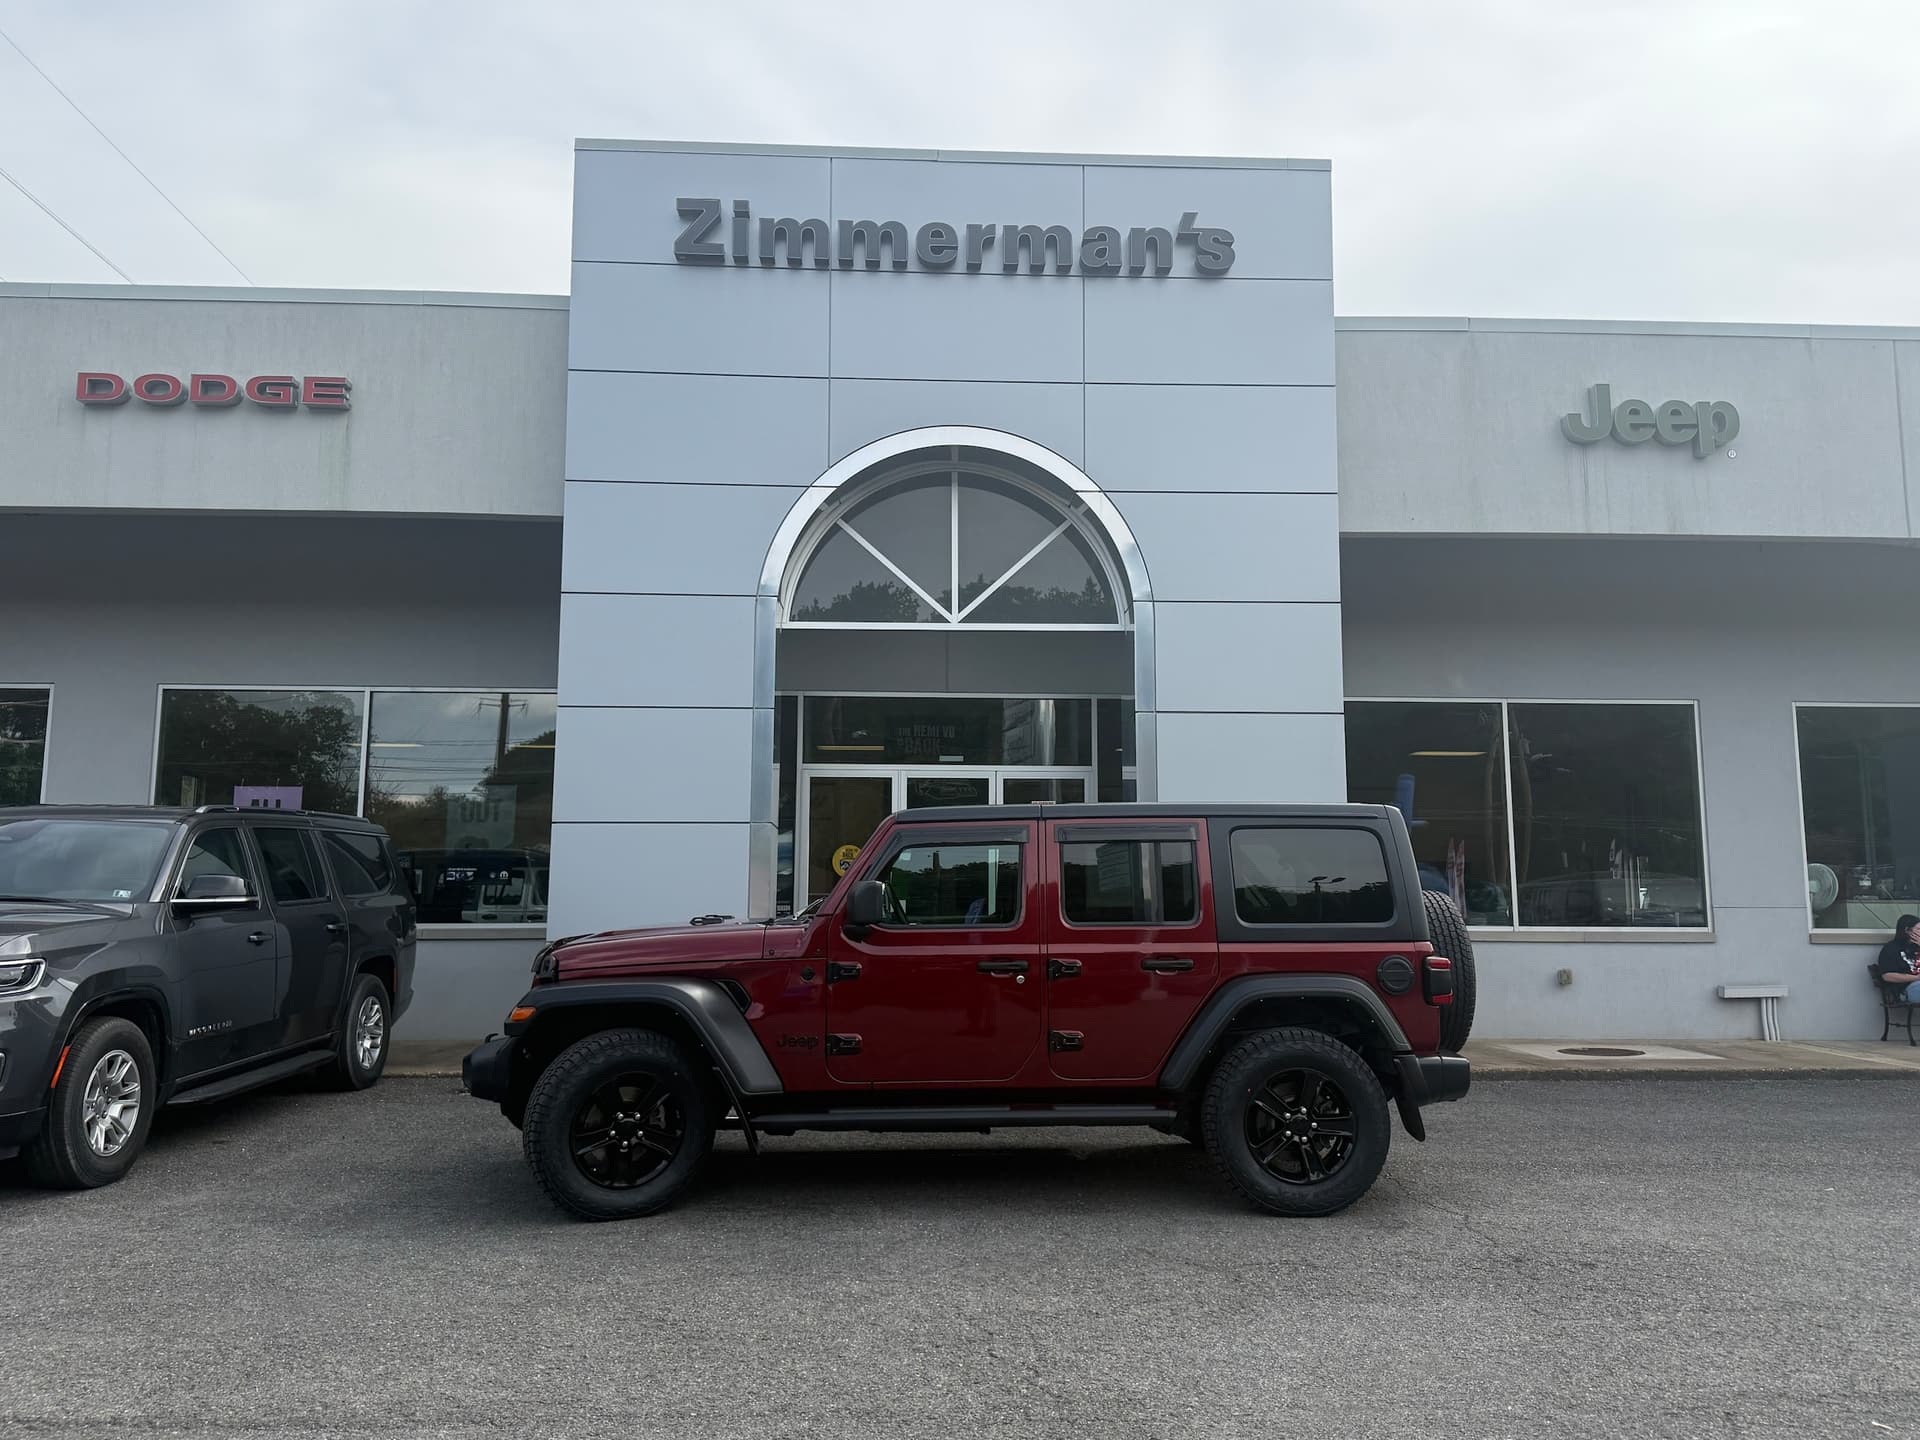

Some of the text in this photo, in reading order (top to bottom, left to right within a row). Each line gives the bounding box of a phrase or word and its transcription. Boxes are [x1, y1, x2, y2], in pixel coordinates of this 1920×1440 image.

[674, 198, 1235, 275] Zimmerman's
[76, 372, 351, 410] DODGE
[1560, 384, 1740, 459] Jeep
